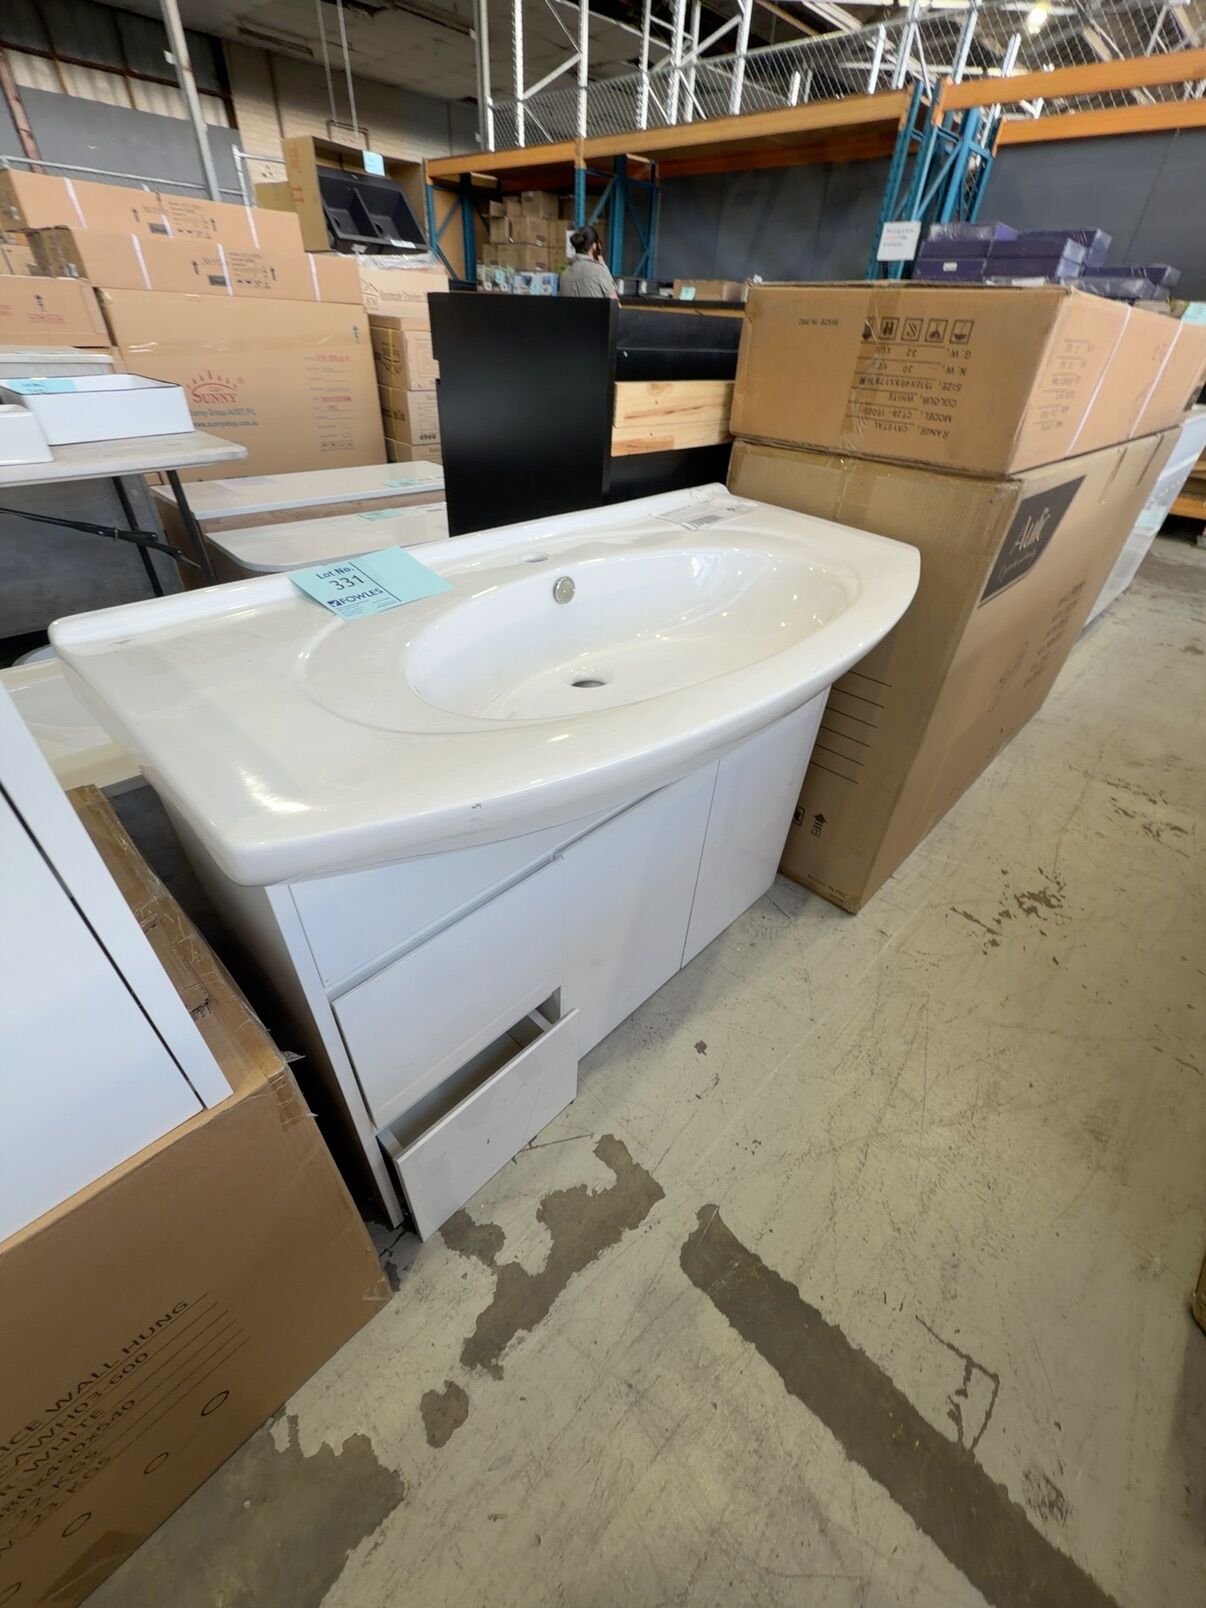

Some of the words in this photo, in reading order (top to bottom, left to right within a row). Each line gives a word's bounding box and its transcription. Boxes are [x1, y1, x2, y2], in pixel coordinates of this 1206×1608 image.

[191, 391, 238, 404] SUNNY
[887, 392, 914, 402] WHITE
[874, 421, 909, 434] CRYSTAL
[316, 570, 334, 580] Lot
[335, 565, 355, 577] No.
[328, 574, 365, 591] 331
[339, 587, 384, 605] FOWLES
[45, 1359, 118, 1414] WALL
[121, 1301, 189, 1355] HUNG
[109, 1352, 149, 1386] 600
[23, 1409, 106, 1473] WHITE
[51, 1450, 99, 1489] KGS
[67, 1454, 112, 1493] KGS
